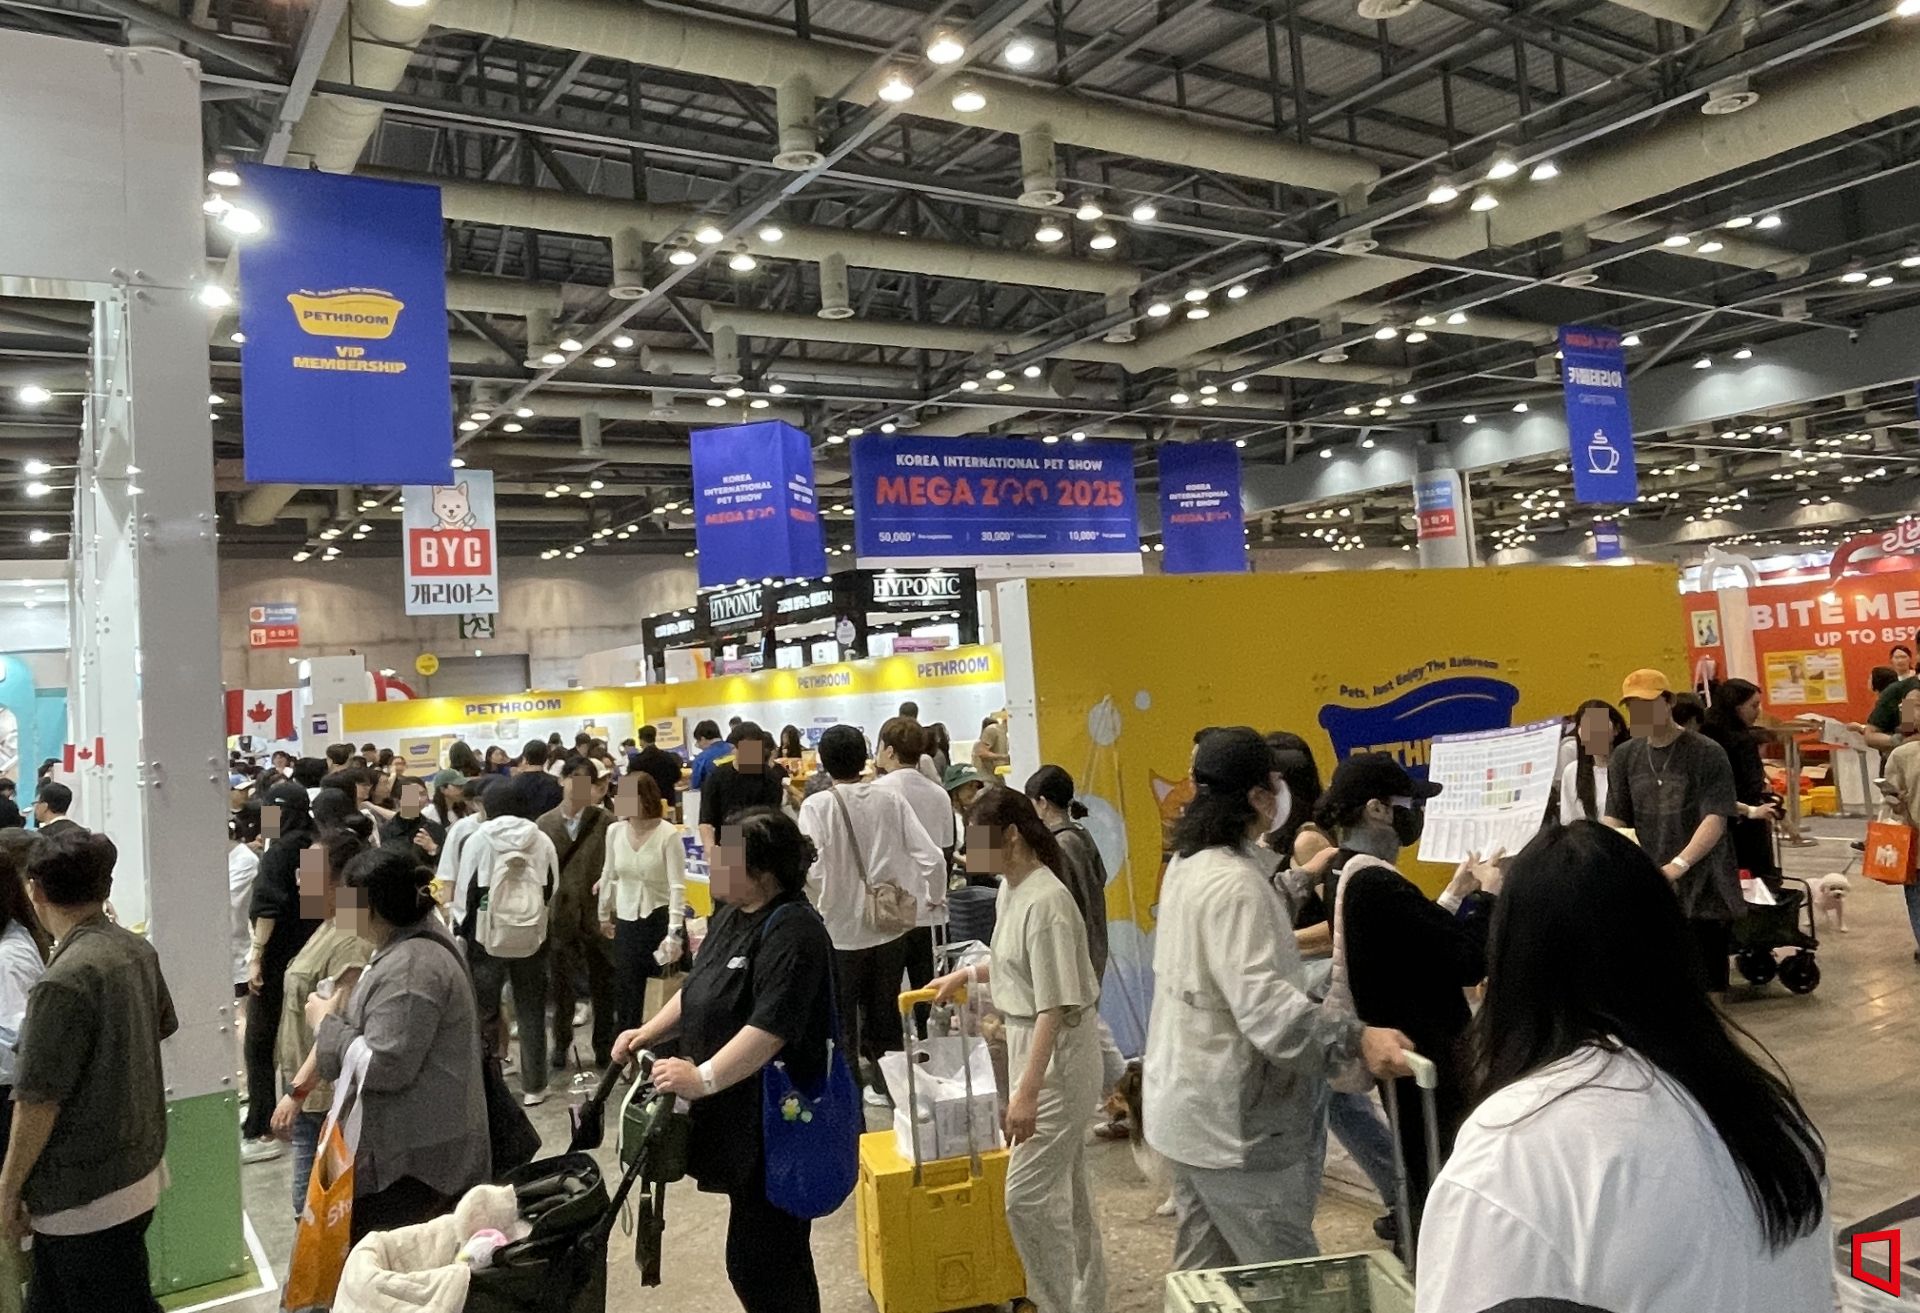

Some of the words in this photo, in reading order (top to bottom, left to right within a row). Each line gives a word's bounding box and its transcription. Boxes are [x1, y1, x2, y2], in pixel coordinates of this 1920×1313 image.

[303, 311, 389, 325] PETHROOM
[336, 346, 365, 358] VIP
[293, 356, 407, 373] MEMBERSHIP
[896, 454, 939, 467] KOREA
[943, 455, 1040, 469] INTERNATIONAL
[1044, 458, 1064, 470] PET
[1068, 459, 1103, 471] SHOW
[722, 474, 752, 484] KOREA
[704, 481, 773, 496] INTERNATIONAL
[876, 475, 976, 506] MEGA
[1056, 479, 1124, 507] 2025
[717, 496, 733, 505] PET
[420, 537, 481, 568] BYC
[411, 583, 494, 605] 개리야스
[873, 577, 960, 597] HYPONIC
[709, 590, 763, 620] HYPONIC
[1749, 597, 1845, 631] BITE
[1855, 591, 1920, 622] ME
[1814, 631, 1842, 647] UP
[1846, 629, 1876, 645] TO
[917, 656, 990, 678] PETHROOM
[798, 672, 850, 690] PETHROOM
[1340, 684, 1369, 699] Pets,
[1373, 680, 1395, 696] Just
[1396, 667, 1425, 686] Enjoy
[1426, 659, 1446, 673] The
[1449, 657, 1499, 669] Bathroom
[465, 699, 561, 716] PETHROOM
